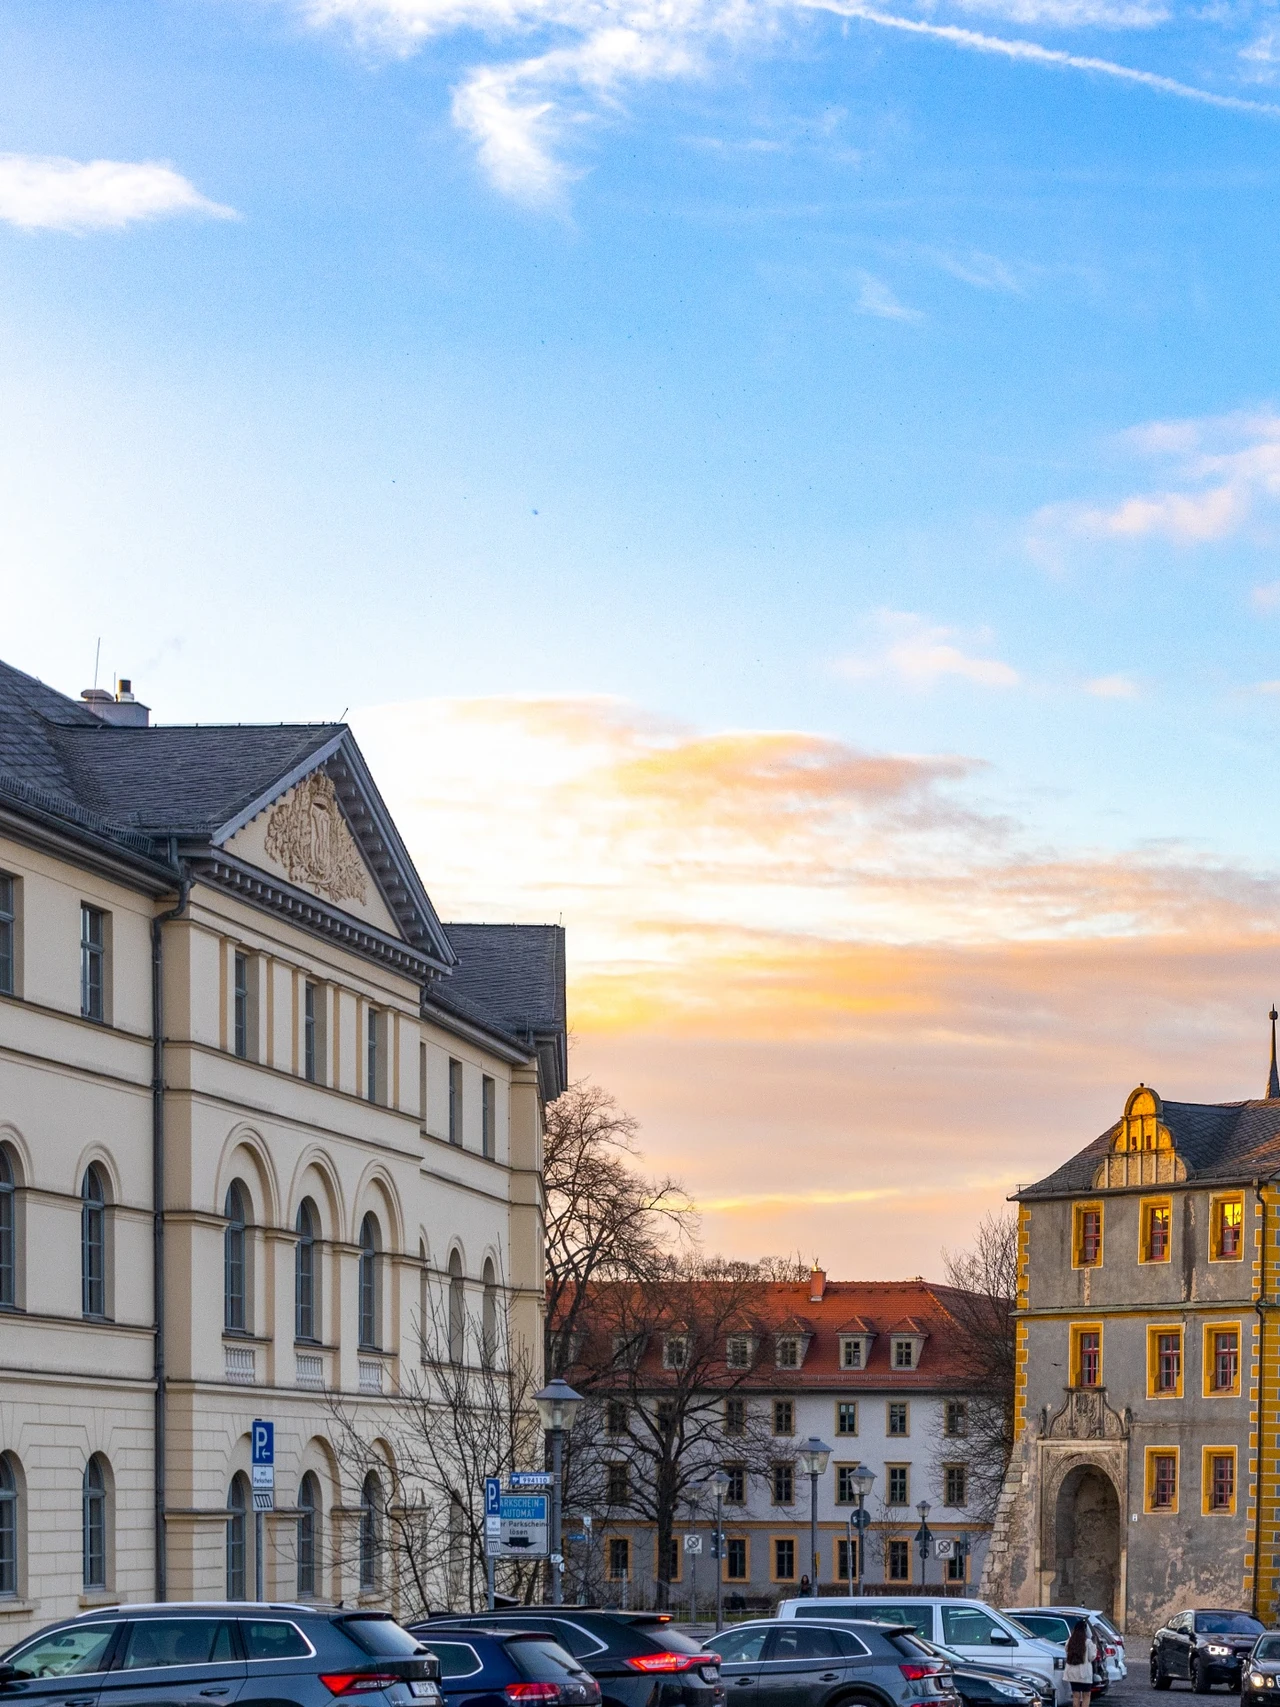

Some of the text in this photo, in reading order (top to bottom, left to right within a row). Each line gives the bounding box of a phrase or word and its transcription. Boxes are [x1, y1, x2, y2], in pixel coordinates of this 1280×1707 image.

[255, 1427, 268, 1459] P
[488, 1483, 497, 1511] P
[500, 1498, 544, 1508] ARKSCHEIN-
[502, 1508, 536, 1518] AUTOMAT
